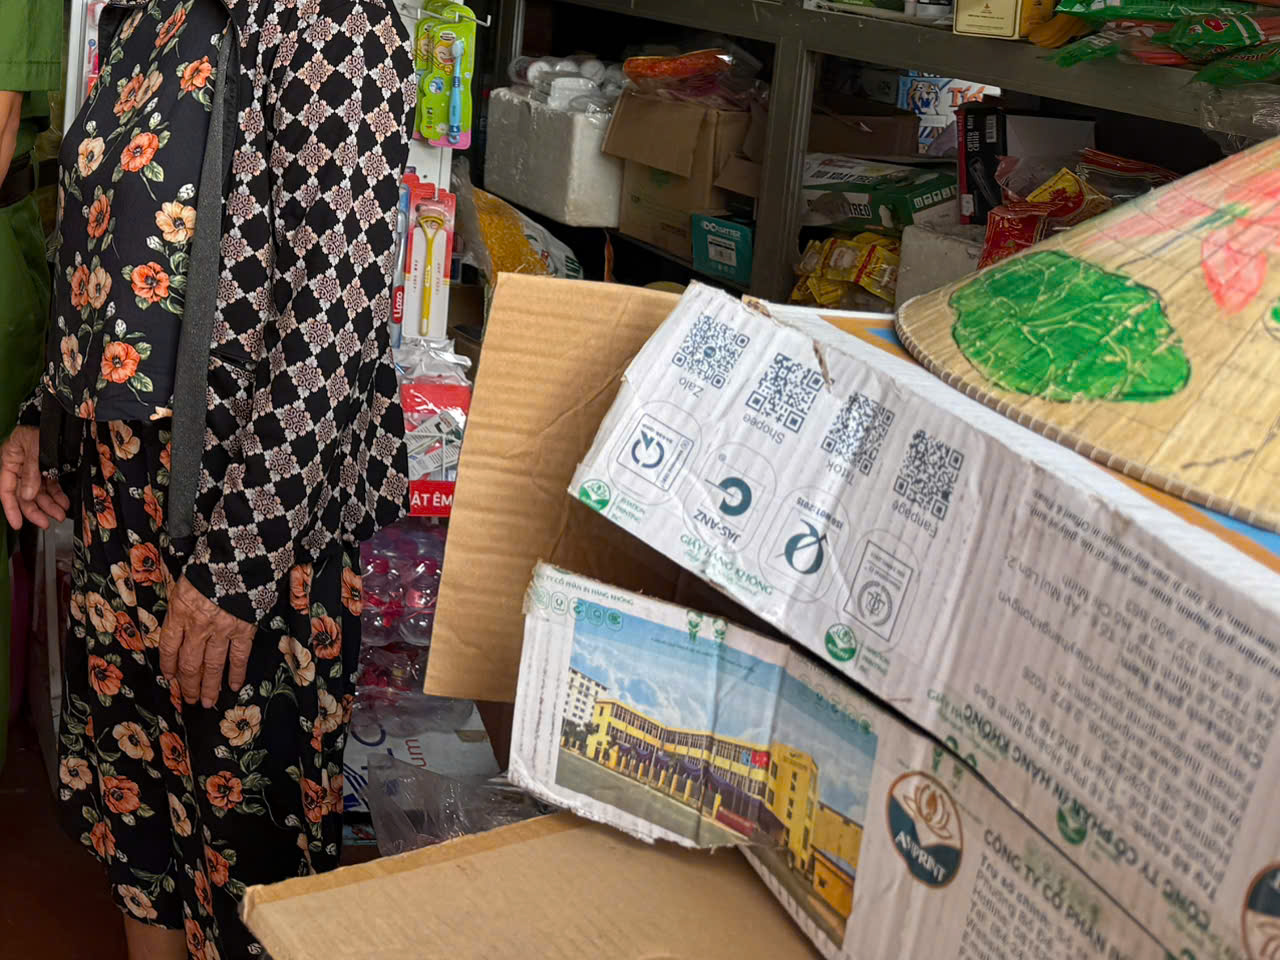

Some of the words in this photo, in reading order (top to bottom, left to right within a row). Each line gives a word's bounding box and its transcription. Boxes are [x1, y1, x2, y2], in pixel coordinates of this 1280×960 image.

[675, 375, 705, 399] Zalo
[739, 410, 787, 445] Shopee
[691, 508, 743, 544] JAS-ANZ
[887, 498, 940, 537] Fanpage
[983, 829, 1021, 871] CÔNG
[1137, 856, 1161, 888] TY
